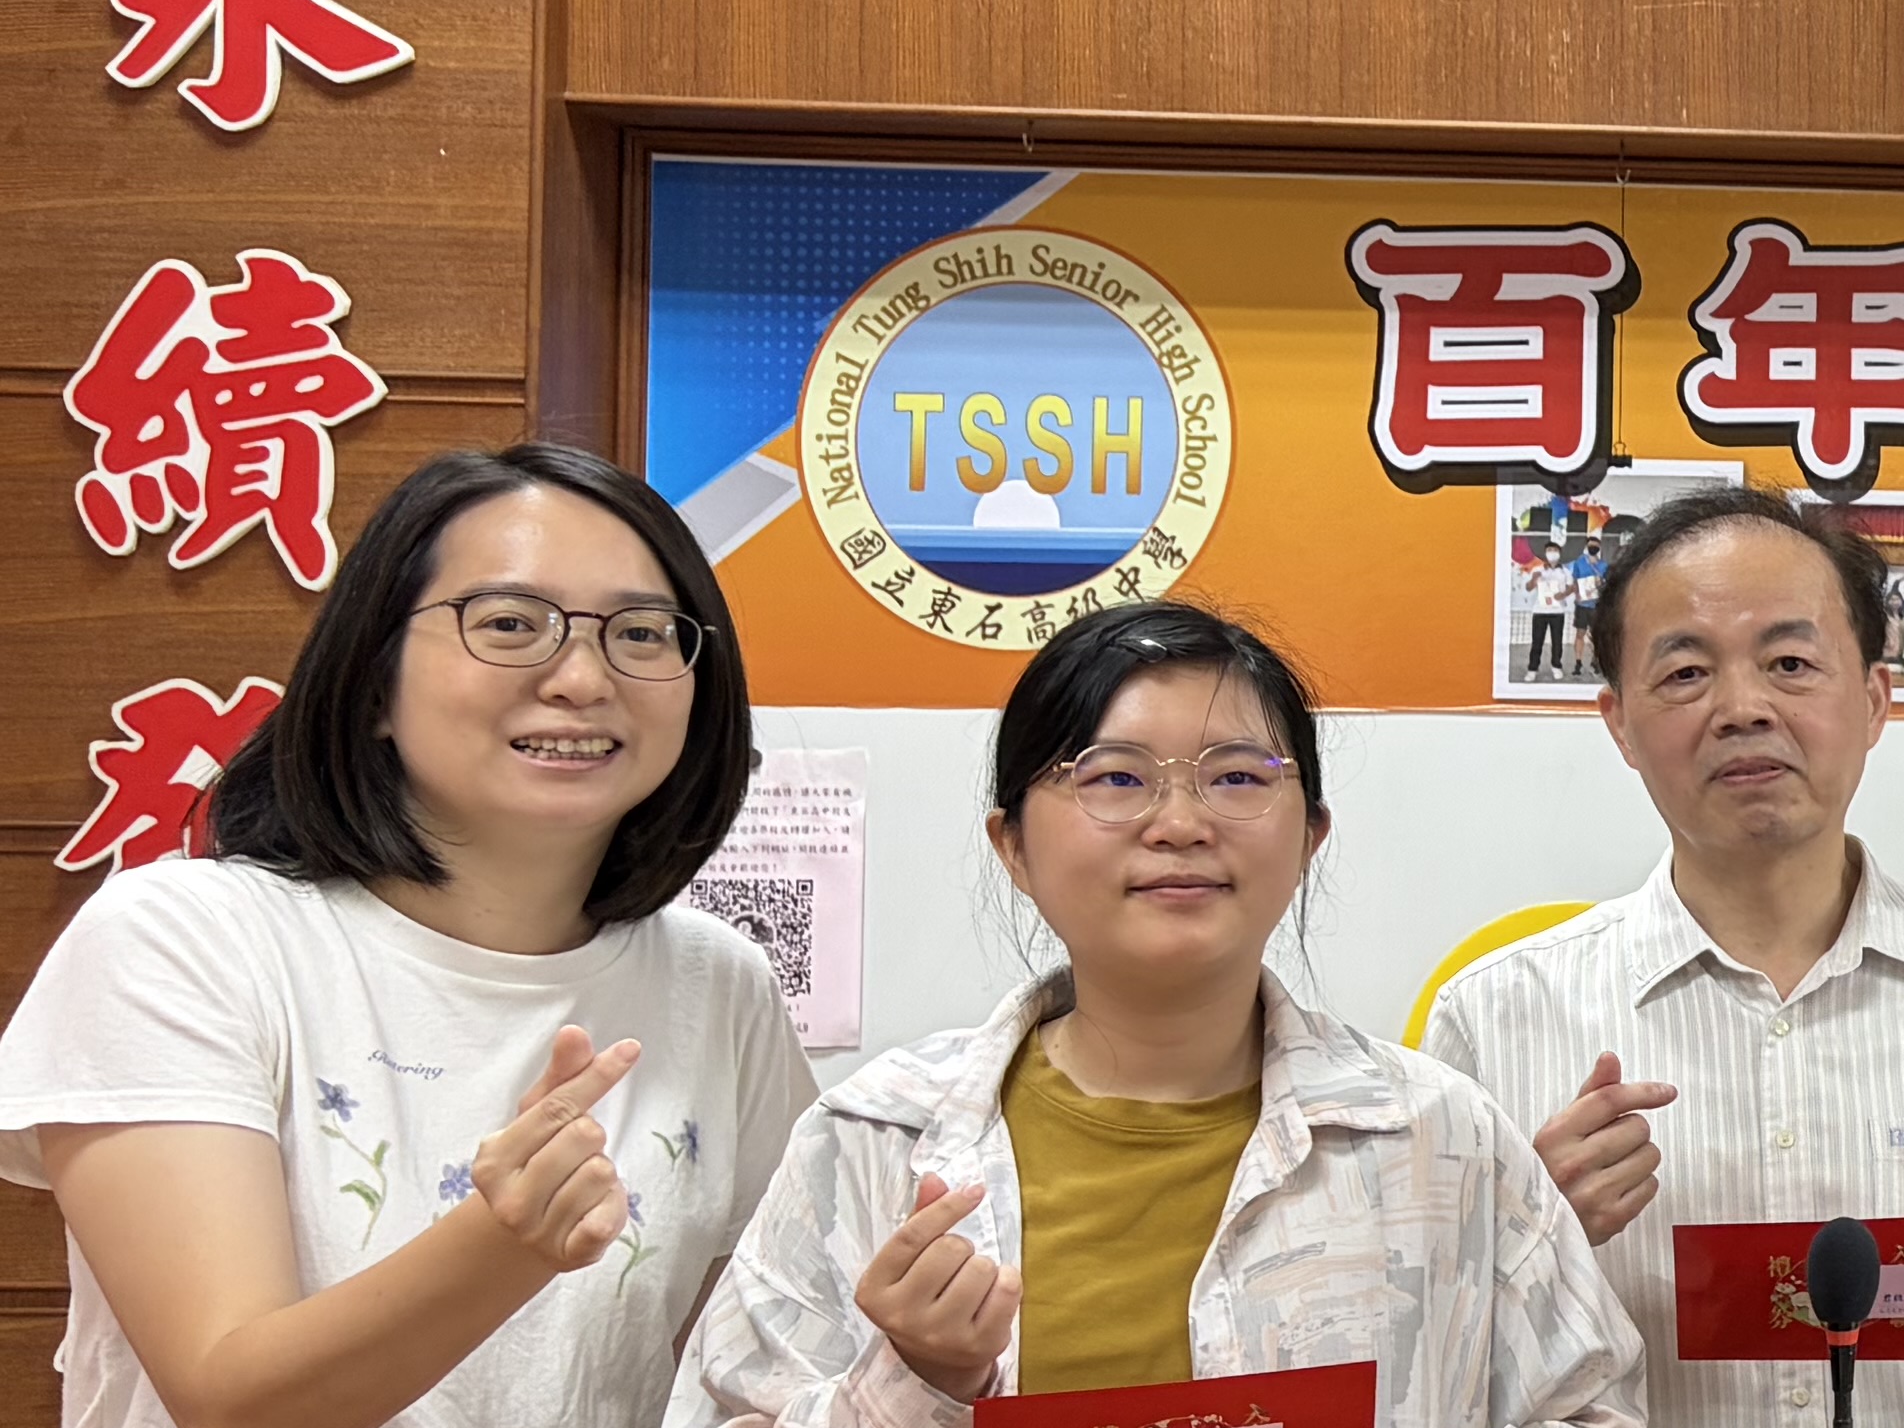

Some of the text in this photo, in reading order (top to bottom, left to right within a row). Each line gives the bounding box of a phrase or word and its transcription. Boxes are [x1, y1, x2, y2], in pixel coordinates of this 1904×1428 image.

[815, 243, 1220, 510] National Tung Shih Senior High School
[893, 391, 1144, 496] TSSH
